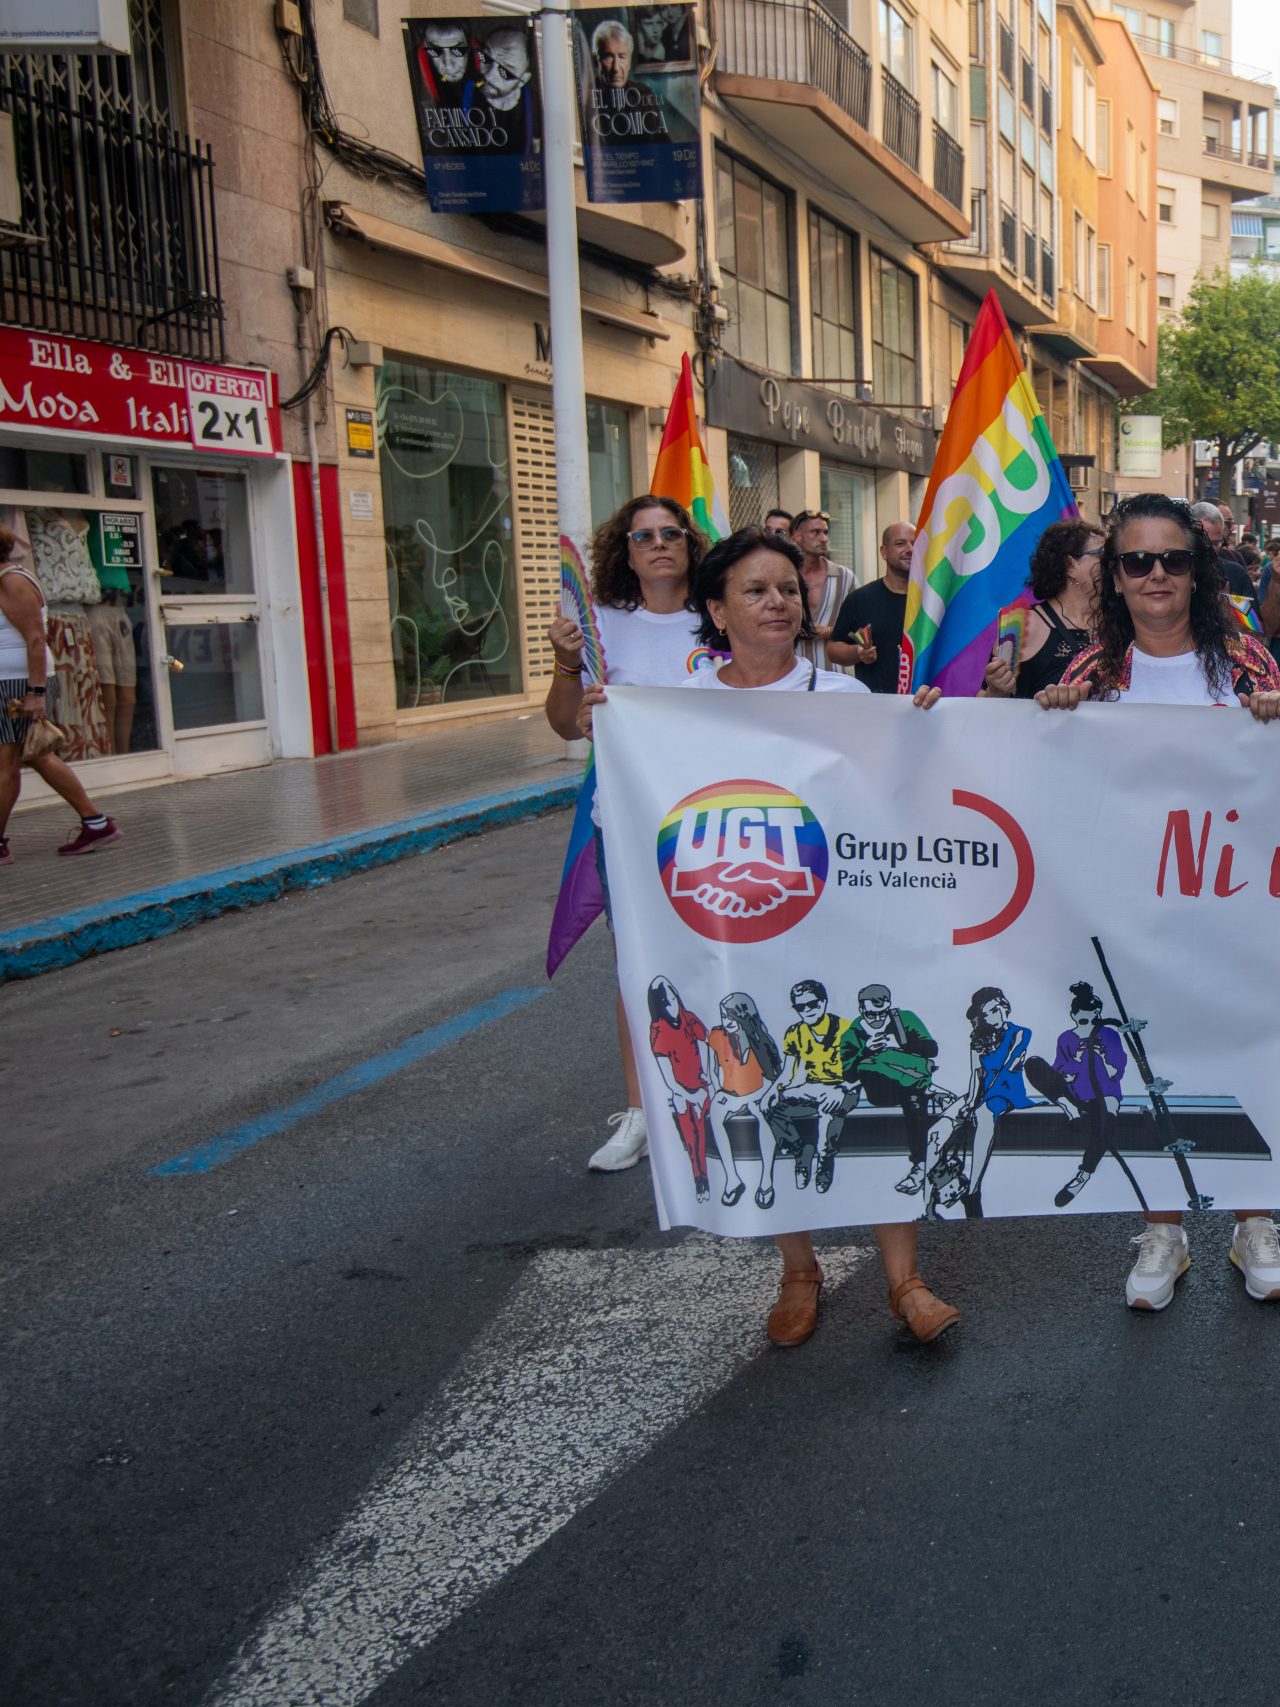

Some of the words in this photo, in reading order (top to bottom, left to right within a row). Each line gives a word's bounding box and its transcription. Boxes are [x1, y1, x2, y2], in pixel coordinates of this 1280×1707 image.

[592, 89, 608, 109] EL
[429, 127, 508, 148] CANSADO
[28, 339, 93, 375] Ella
[109, 352, 132, 381] &
[147, 358, 185, 389] Ell
[191, 372, 261, 400] OFERTA
[0, 377, 100, 424] Moda
[126, 396, 190, 435] Itali
[198, 401, 263, 446] 2x1
[761, 377, 810, 441] Pepe
[674, 807, 805, 868] UGT
[836, 832, 908, 868] Grup
[917, 836, 999, 868] LGTBI
[1157, 809, 1248, 898] Ni
[837, 869, 873, 888] País
[879, 871, 958, 890] Valencià
